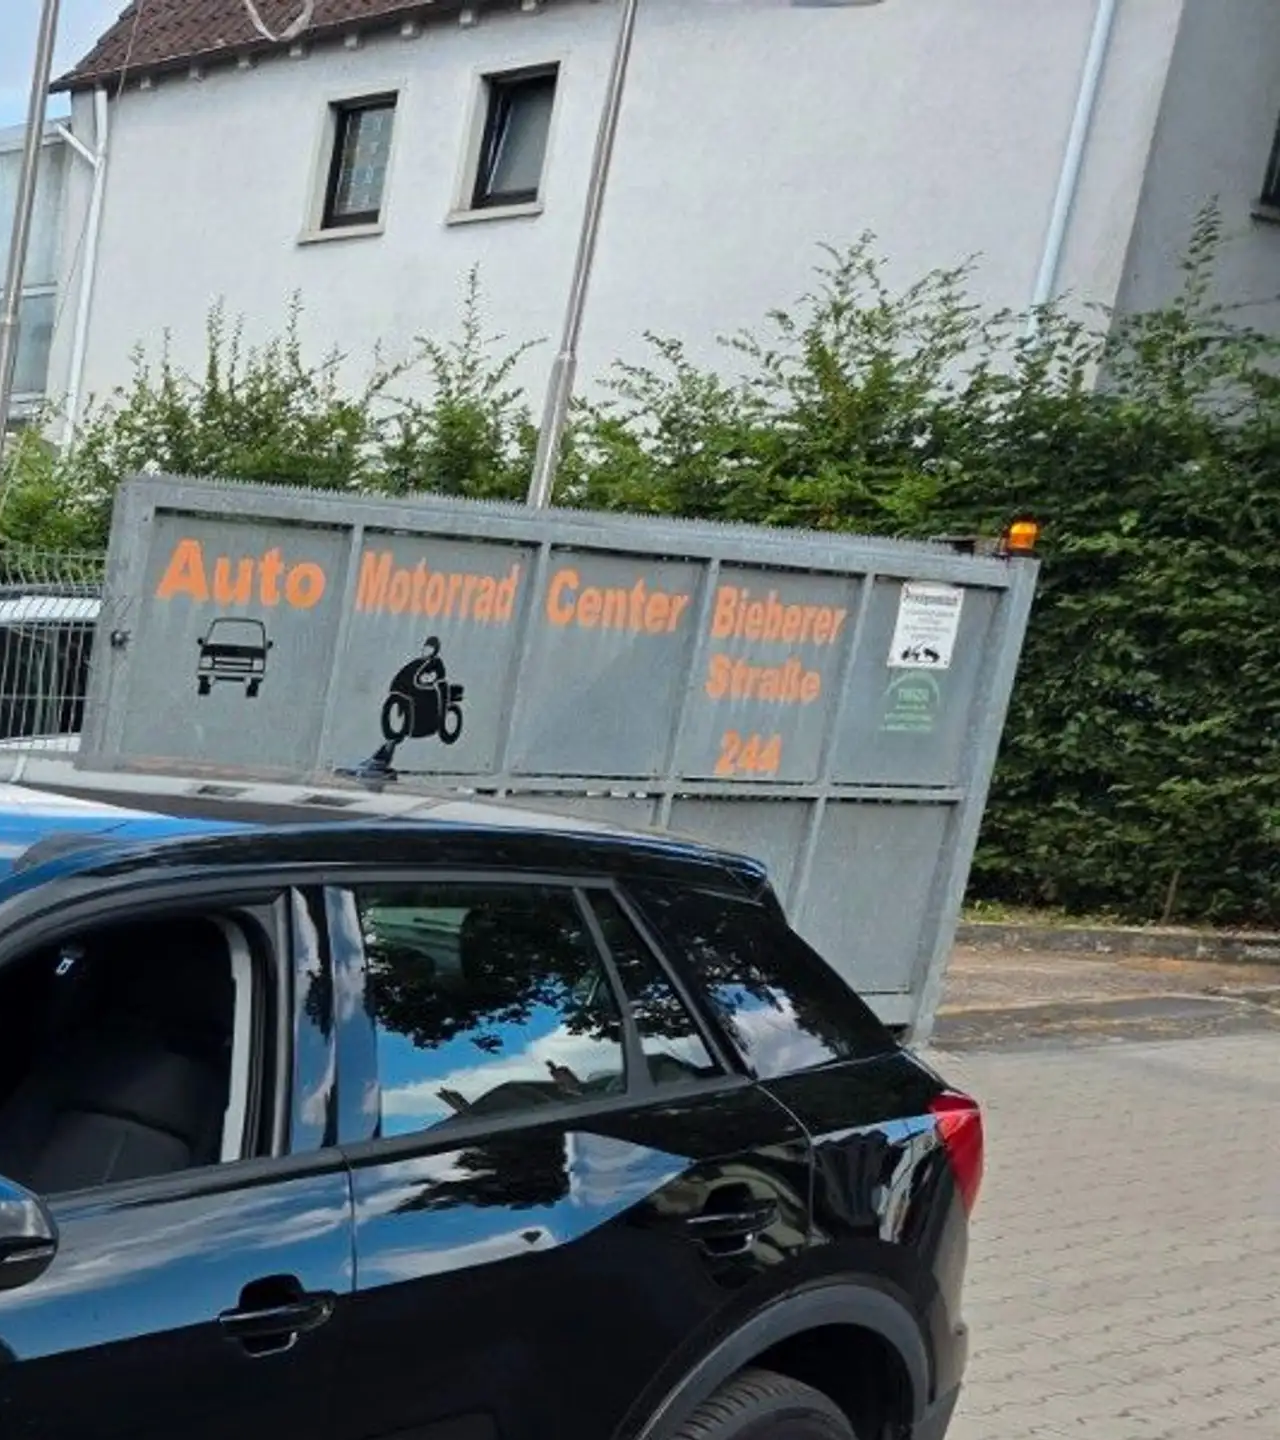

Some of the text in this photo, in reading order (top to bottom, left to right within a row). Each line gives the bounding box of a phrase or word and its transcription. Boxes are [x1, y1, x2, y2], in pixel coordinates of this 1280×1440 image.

[156, 537, 848, 646] Auto Motorrad Center Bieberer
[705, 652, 821, 705] Straße
[715, 729, 782, 777] 244
